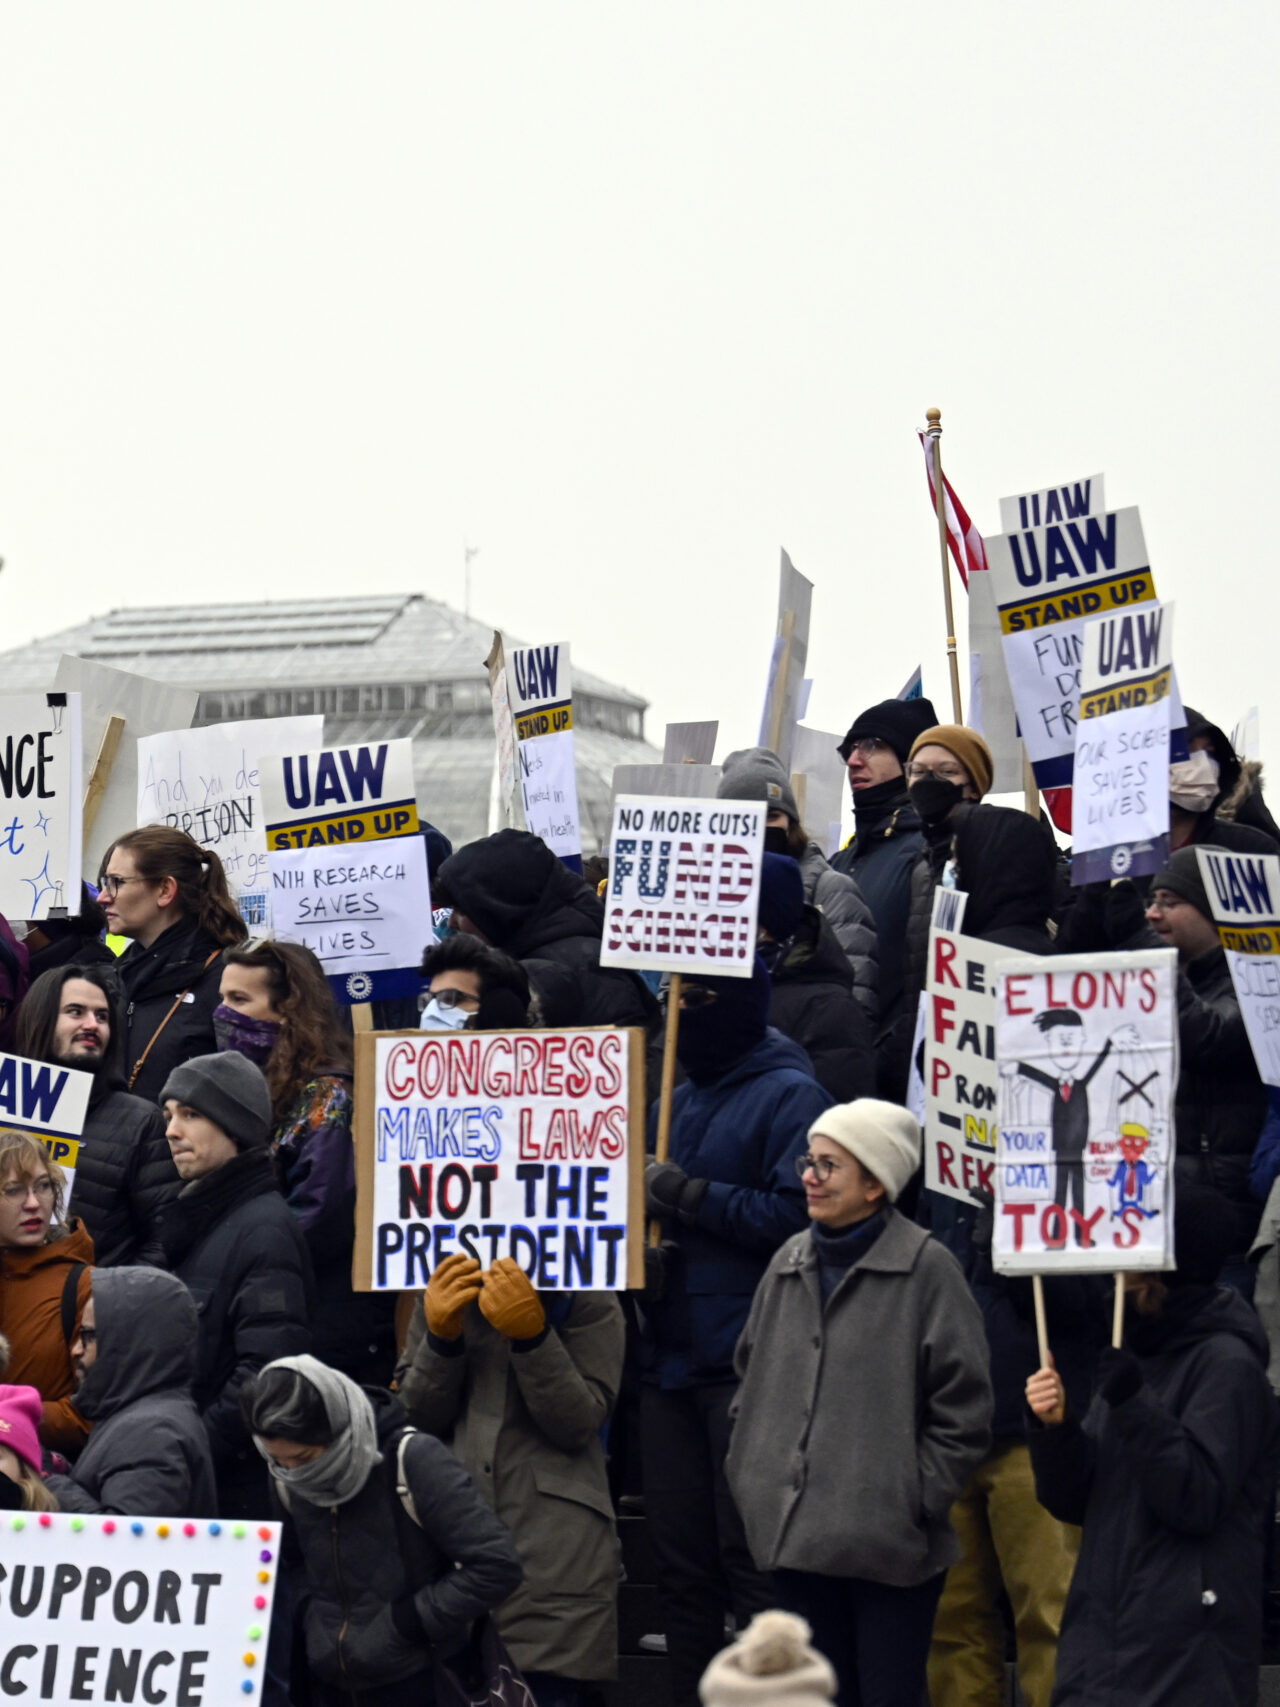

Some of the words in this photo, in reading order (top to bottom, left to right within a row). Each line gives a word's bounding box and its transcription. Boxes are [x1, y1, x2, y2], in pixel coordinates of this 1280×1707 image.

[1008, 512, 1117, 588] UAW
[1008, 591, 1101, 633] STAND
[1109, 579, 1147, 606] UP
[1097, 606, 1164, 678] UAW
[513, 644, 560, 701] UAW
[518, 715, 549, 740] STAND
[552, 709, 569, 732] UP
[1084, 688, 1148, 720] STAND
[282, 743, 389, 811] UAW
[1091, 760, 1149, 797] SAVES
[274, 818, 366, 851] STAND
[373, 810, 411, 835] UP
[618, 808, 645, 832] NO
[649, 810, 703, 834] MORE
[708, 812, 759, 837] CUTS!
[1087, 790, 1149, 825] LIVES
[272, 869, 305, 889] NIH
[314, 863, 407, 890] RESEARCH
[611, 838, 754, 908] FUND
[1206, 854, 1275, 916] UAW
[298, 892, 380, 919] SAVES
[302, 930, 376, 953] LIVES
[607, 907, 750, 960] SCIENCE!
[1223, 931, 1273, 952] STAND
[1005, 967, 1157, 1016] ELON'S
[385, 1033, 623, 1101] CONGRESS
[377, 1105, 503, 1163] MAKES
[519, 1104, 627, 1161] LAWS
[1001, 1131, 1047, 1152] YOUR
[398, 1162, 499, 1221] NOT
[515, 1164, 610, 1221] THE
[1005, 1163, 1049, 1189] DATA
[1001, 1203, 1145, 1253] TOYS
